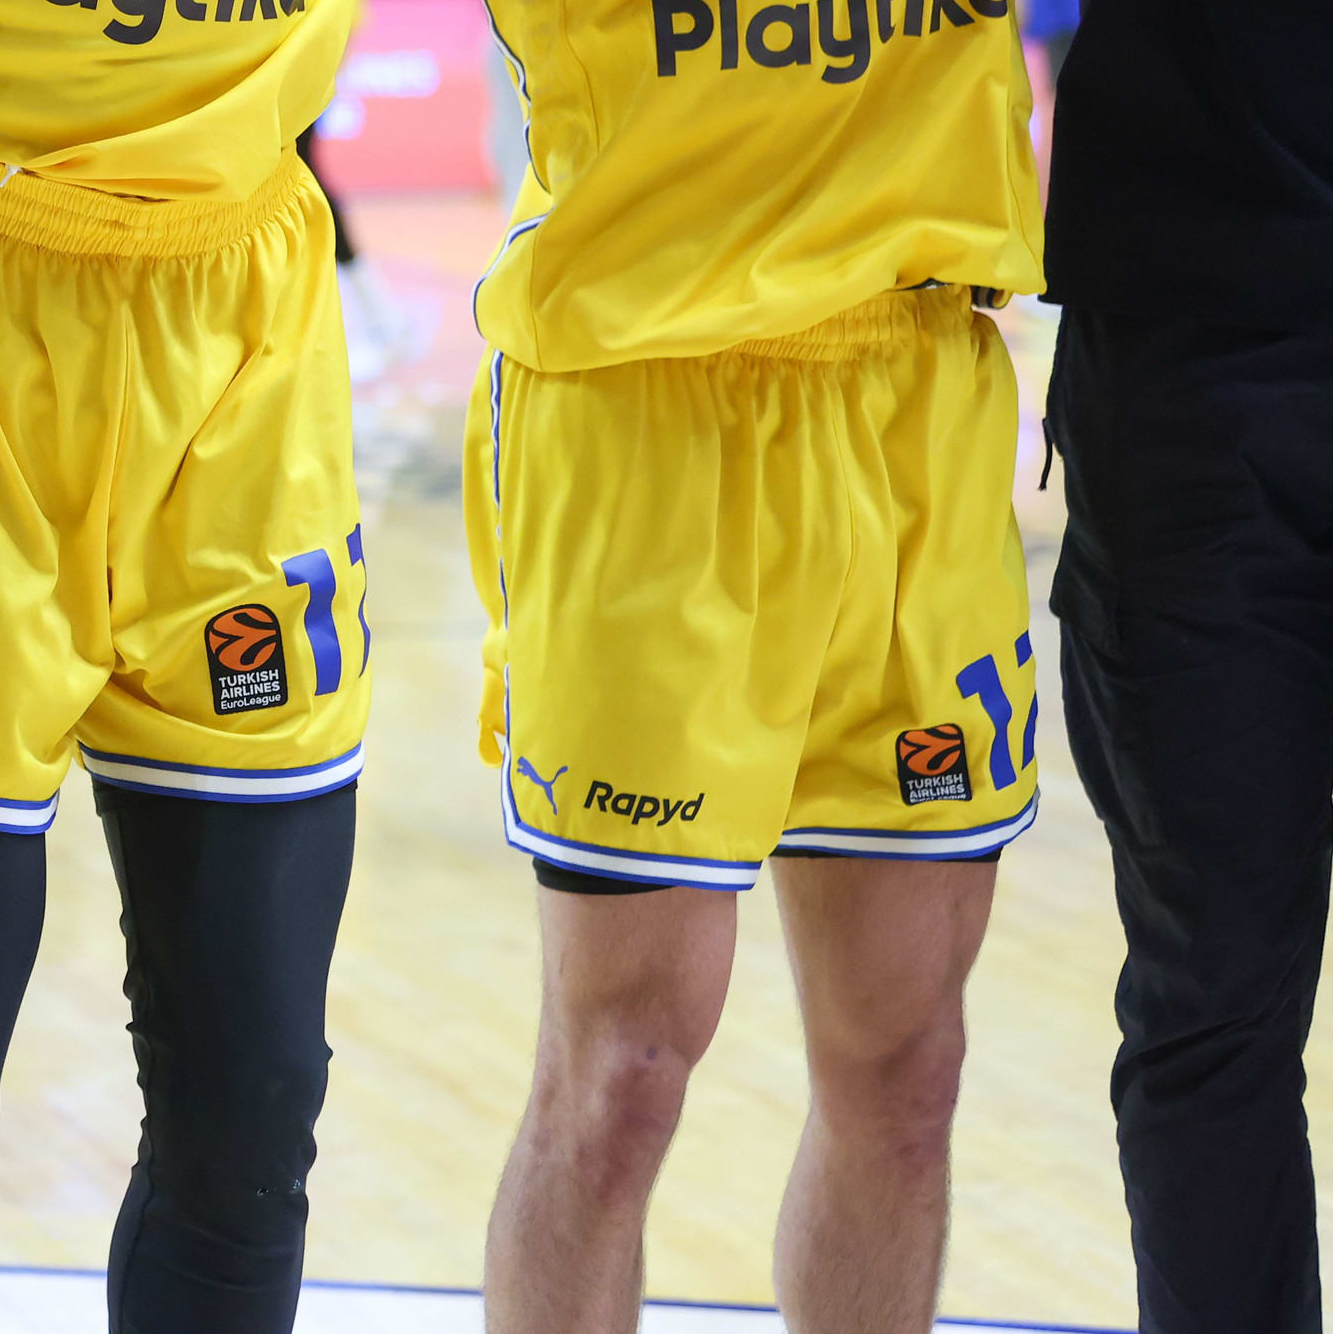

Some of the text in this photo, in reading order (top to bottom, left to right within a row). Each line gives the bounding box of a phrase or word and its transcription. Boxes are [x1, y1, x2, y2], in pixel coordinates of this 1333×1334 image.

[218, 669, 279, 688] TURKISH
[221, 681, 280, 700] AIRLINES
[221, 693, 281, 710] EuroLeague
[907, 773, 962, 790] TURKISH
[909, 784, 965, 799] AIRLINES
[584, 780, 704, 826] Rapyd
